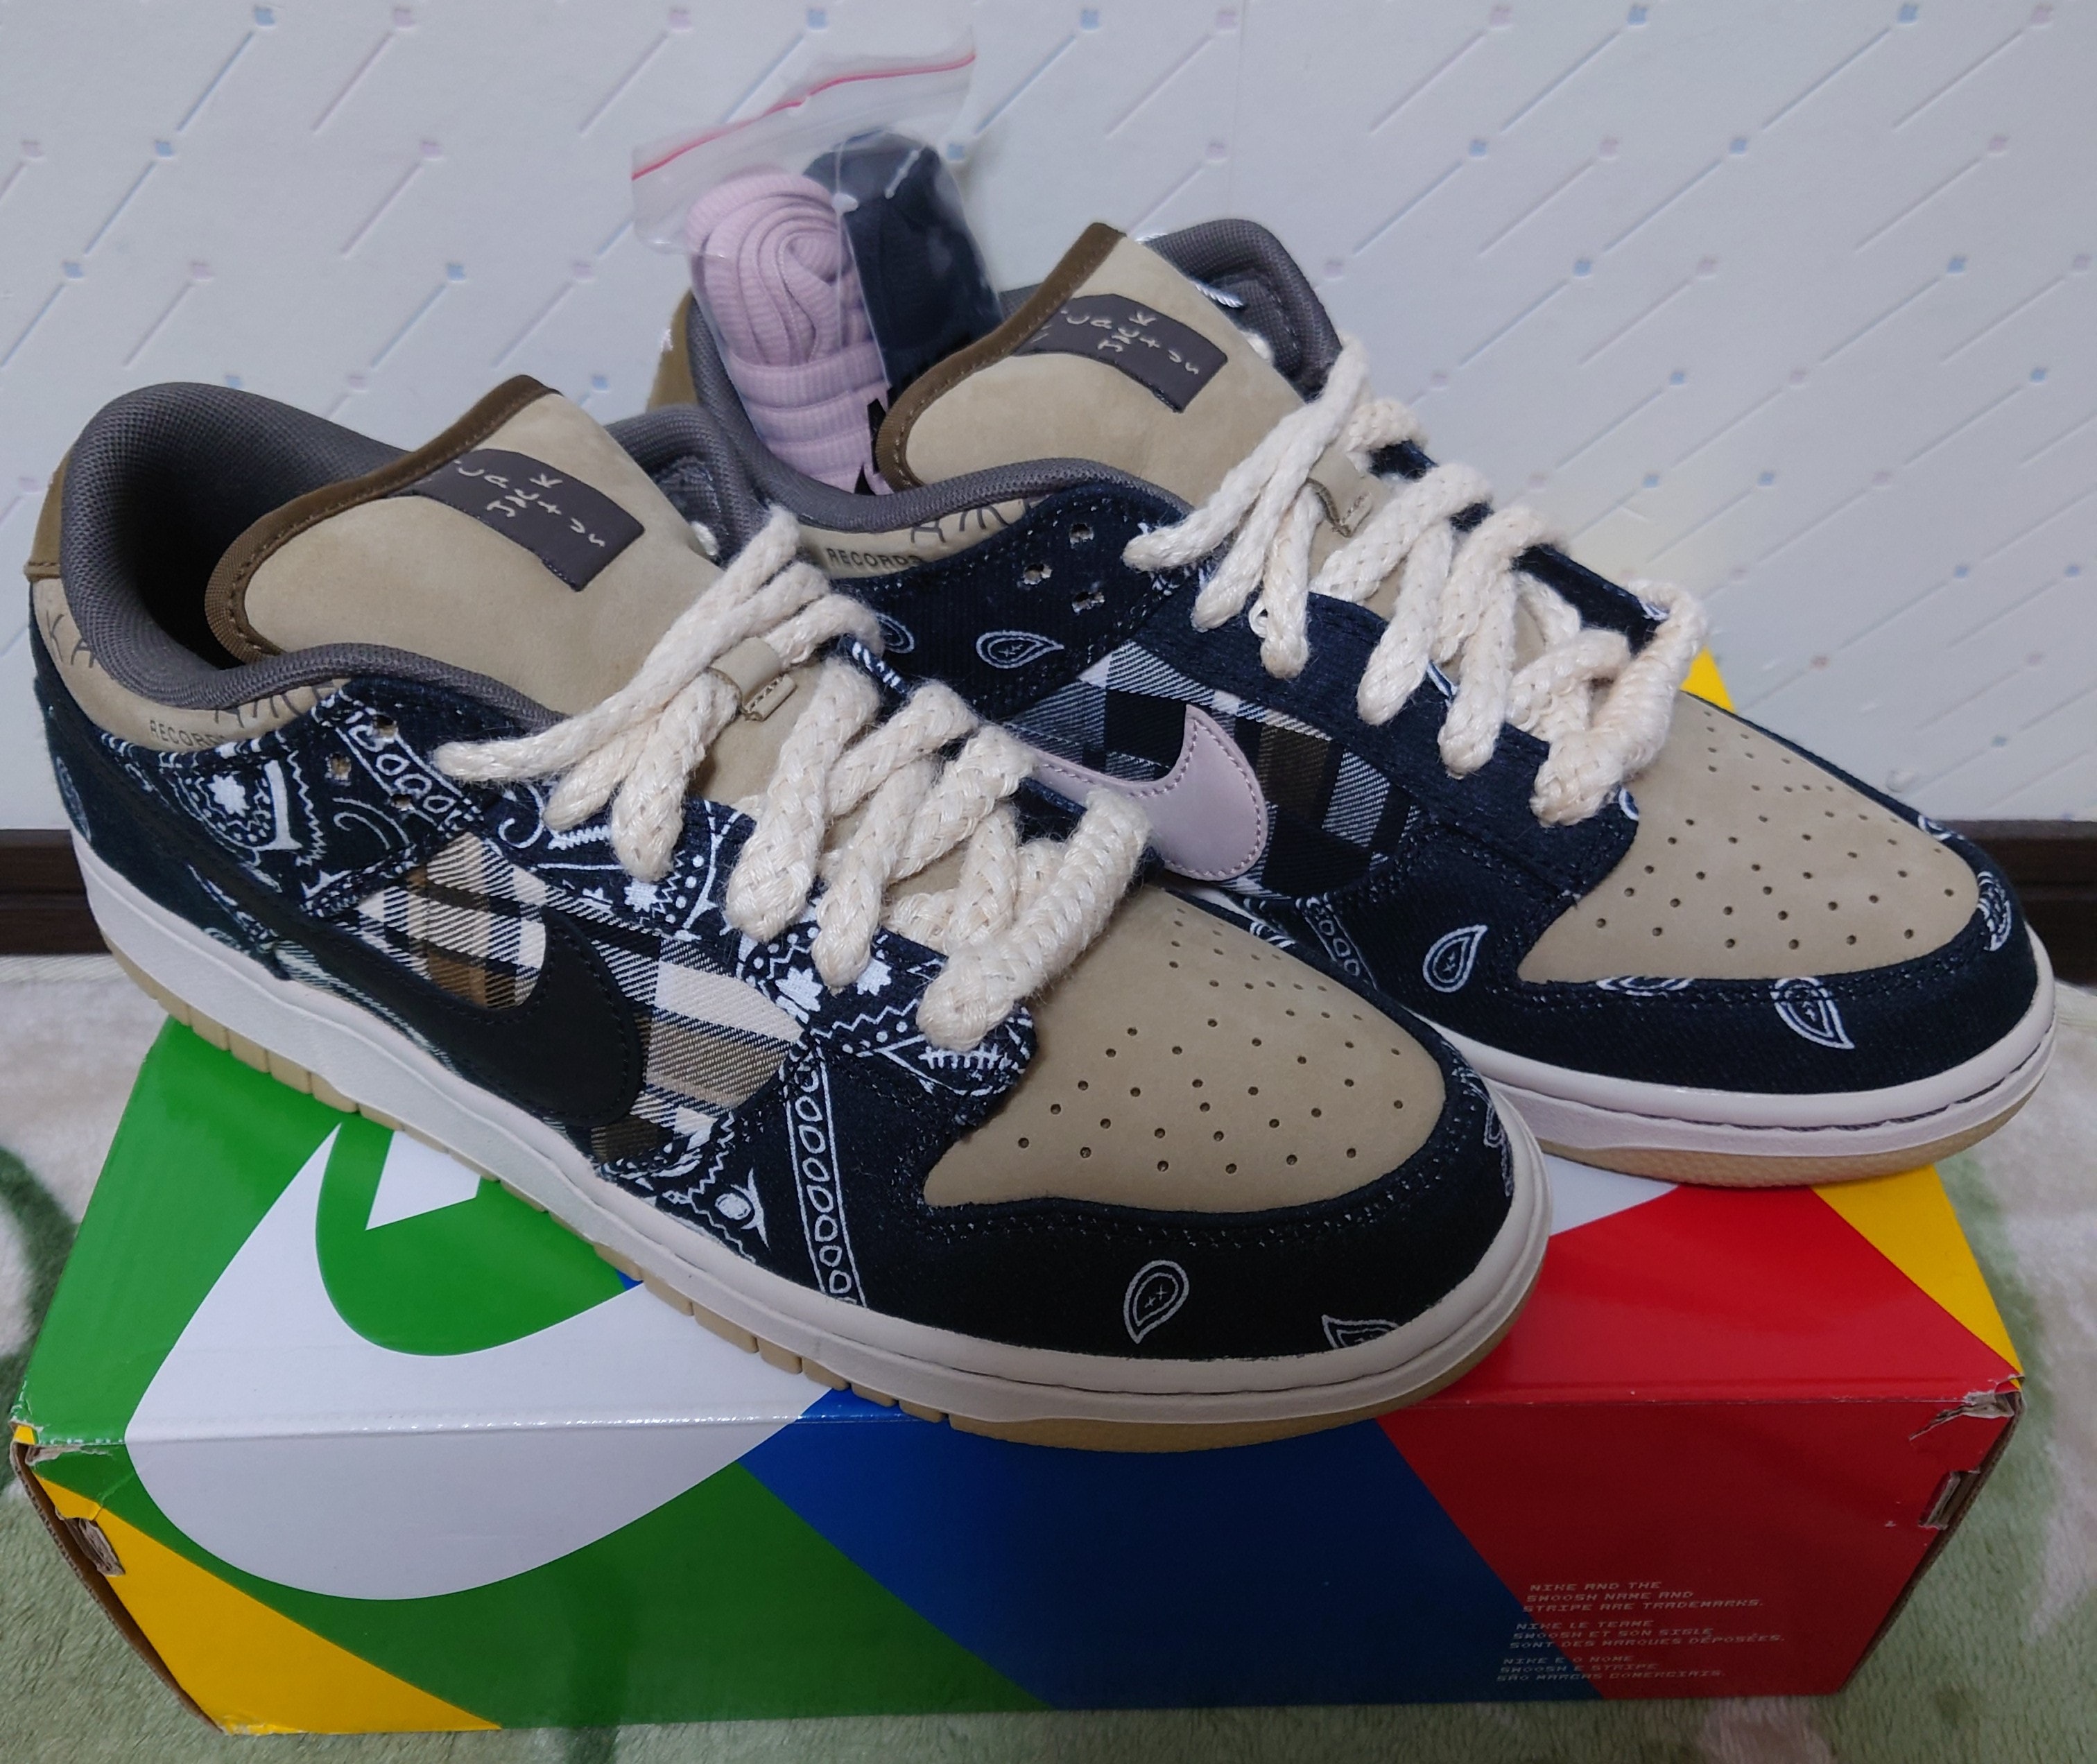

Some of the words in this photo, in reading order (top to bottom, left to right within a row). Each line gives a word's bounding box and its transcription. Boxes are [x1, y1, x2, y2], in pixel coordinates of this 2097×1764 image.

[149, 719, 225, 747] RECORD
[1526, 1594, 1597, 1602] SWOOSH
[1605, 1592, 1652, 1600] NAME
[1523, 1604, 1591, 1612] STRIPE
[1643, 1600, 1764, 1609] TRADEMARKS.
[1513, 1631, 1582, 1640] SWOOSH
